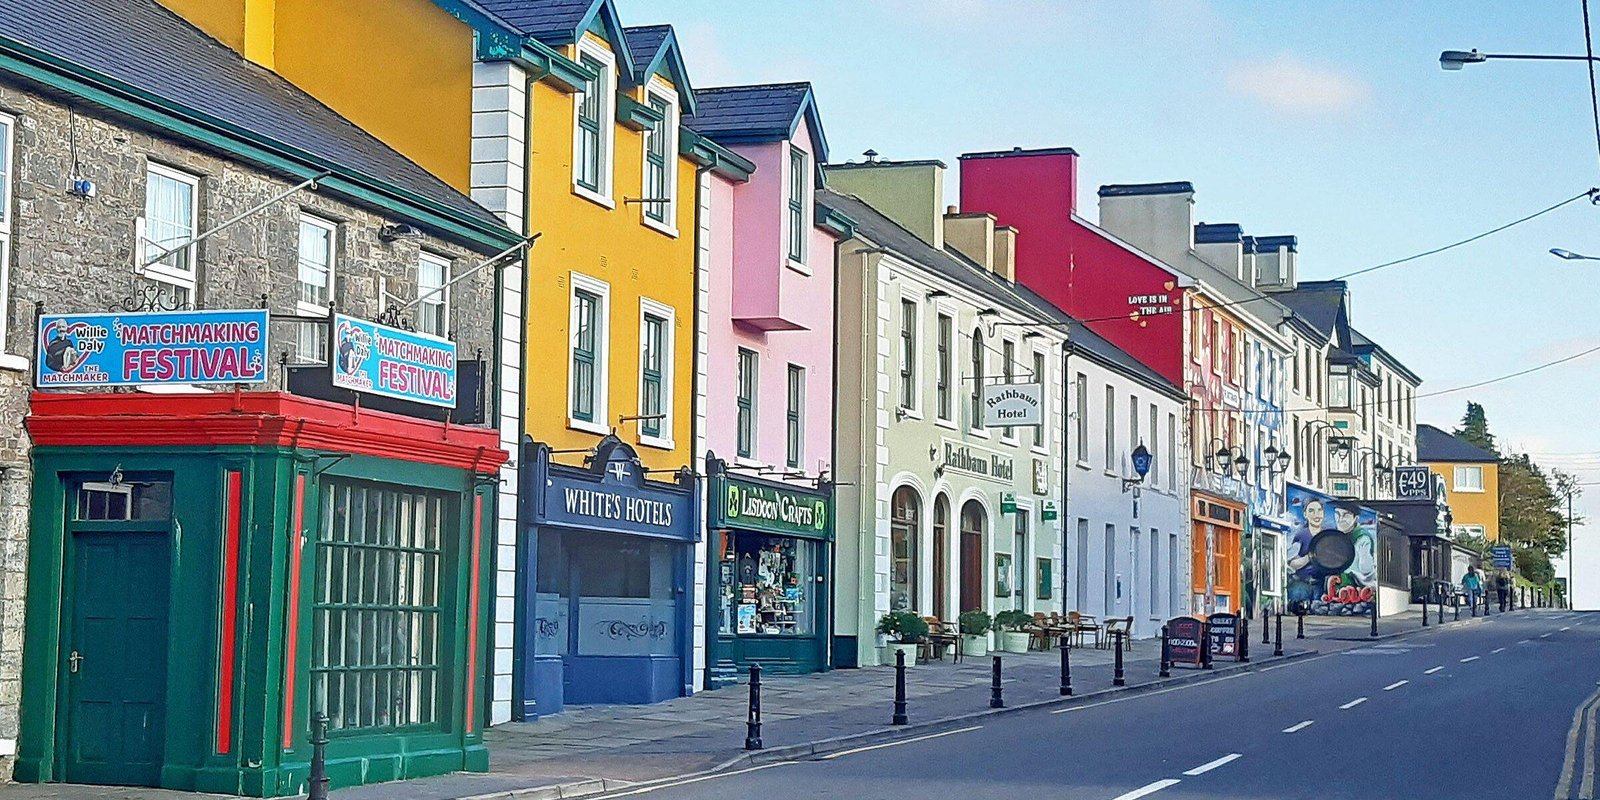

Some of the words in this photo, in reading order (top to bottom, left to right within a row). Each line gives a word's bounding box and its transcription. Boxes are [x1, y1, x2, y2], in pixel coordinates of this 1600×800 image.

[1128, 296, 1148, 304] LOVE
[1149, 295, 1157, 304] IS
[1158, 294, 1168, 303] IN
[1140, 306, 1157, 315] THE
[1158, 306, 1173, 314] AIR
[75, 325, 107, 339] Willie
[121, 322, 259, 345] MATCHMAKING
[78, 340, 104, 352] Daly
[378, 337, 453, 369] MATCHMAKING
[123, 348, 256, 380] FESTIVAL
[43, 373, 108, 382] MATCHMAKER
[379, 359, 451, 400] FESTIVAL
[986, 389, 1038, 409] Rathbaun
[997, 408, 1027, 419] Hotel
[944, 442, 988, 474] Rathbaun
[991, 454, 1013, 481] Hotel
[1398, 471, 1426, 496] €49
[565, 487, 621, 520] WHITE'S
[625, 496, 672, 527] HOTELS
[1320, 575, 1375, 604] Love
